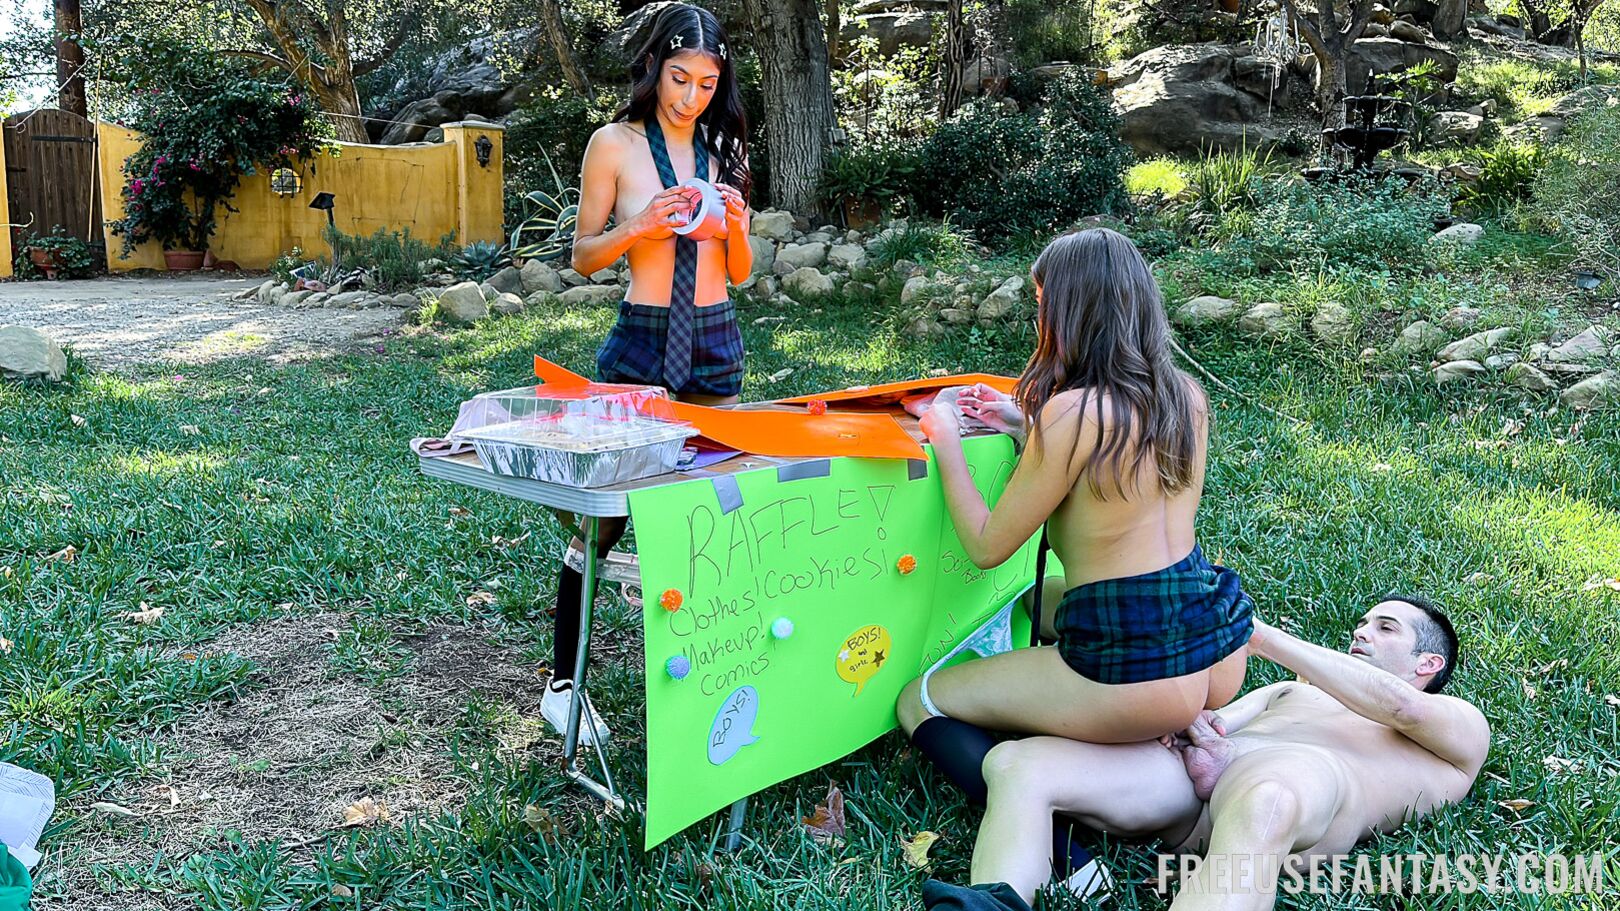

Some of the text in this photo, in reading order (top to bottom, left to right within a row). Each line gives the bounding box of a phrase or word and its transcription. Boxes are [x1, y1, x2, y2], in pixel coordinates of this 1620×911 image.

[686, 484, 896, 599] RAFFLE!
[847, 627, 881, 651] BOYS!
[712, 689, 751, 748] BOYS!
